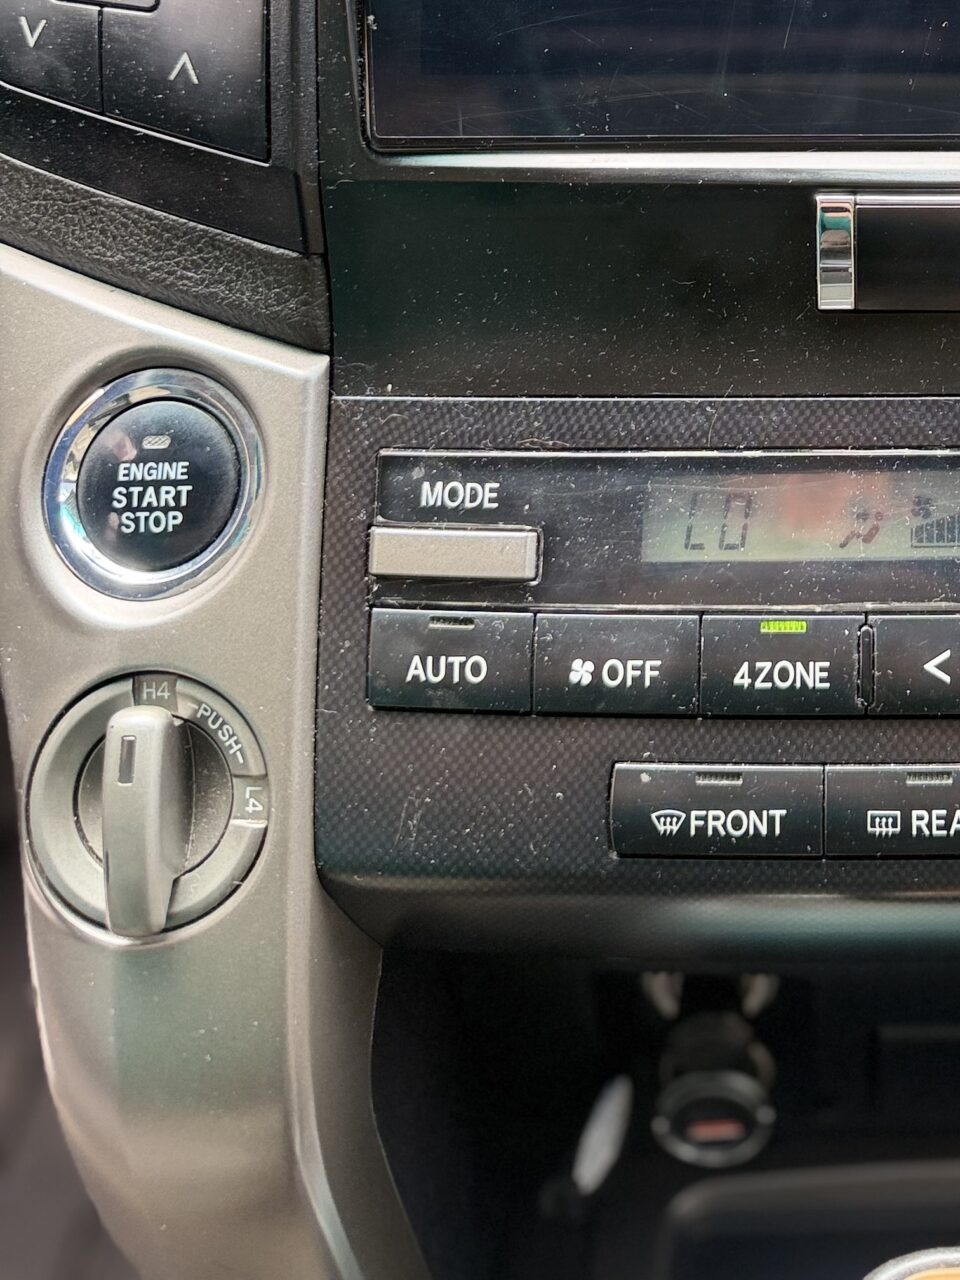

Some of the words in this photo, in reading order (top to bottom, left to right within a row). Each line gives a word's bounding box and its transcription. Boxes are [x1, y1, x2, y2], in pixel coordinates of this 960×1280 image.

[117, 462, 190, 481] ENGINE
[112, 485, 193, 509] START
[420, 481, 500, 510] MODE
[120, 511, 184, 534] STOP
[406, 655, 488, 685] AUTO
[602, 658, 662, 688] OFF
[142, 681, 170, 700] H4
[245, 786, 263, 813] L4
[690, 809, 787, 838] FRONT
